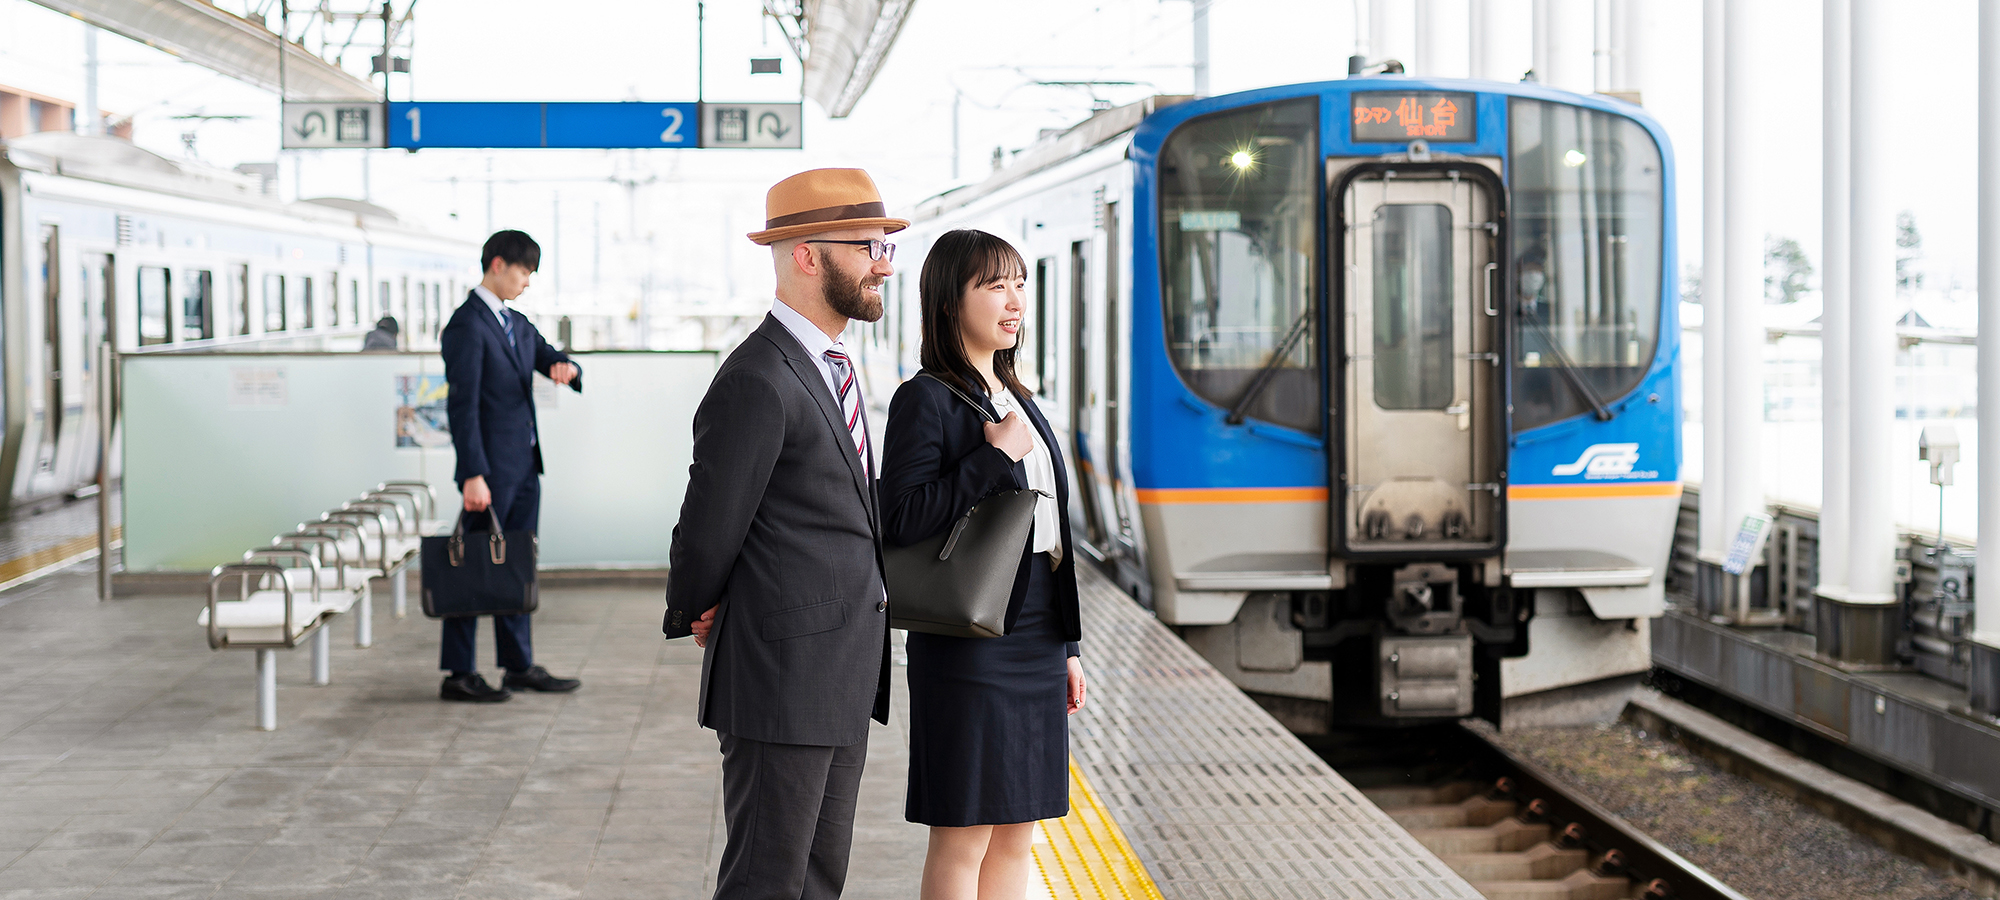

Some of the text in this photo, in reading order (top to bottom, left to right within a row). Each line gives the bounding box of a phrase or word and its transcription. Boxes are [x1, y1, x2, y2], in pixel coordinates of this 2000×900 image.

[405, 106, 421, 142] 1
[660, 107, 684, 143] 2
[1354, 97, 1458, 127] ワンマン 仙台
[1406, 124, 1447, 136] SENDAI
